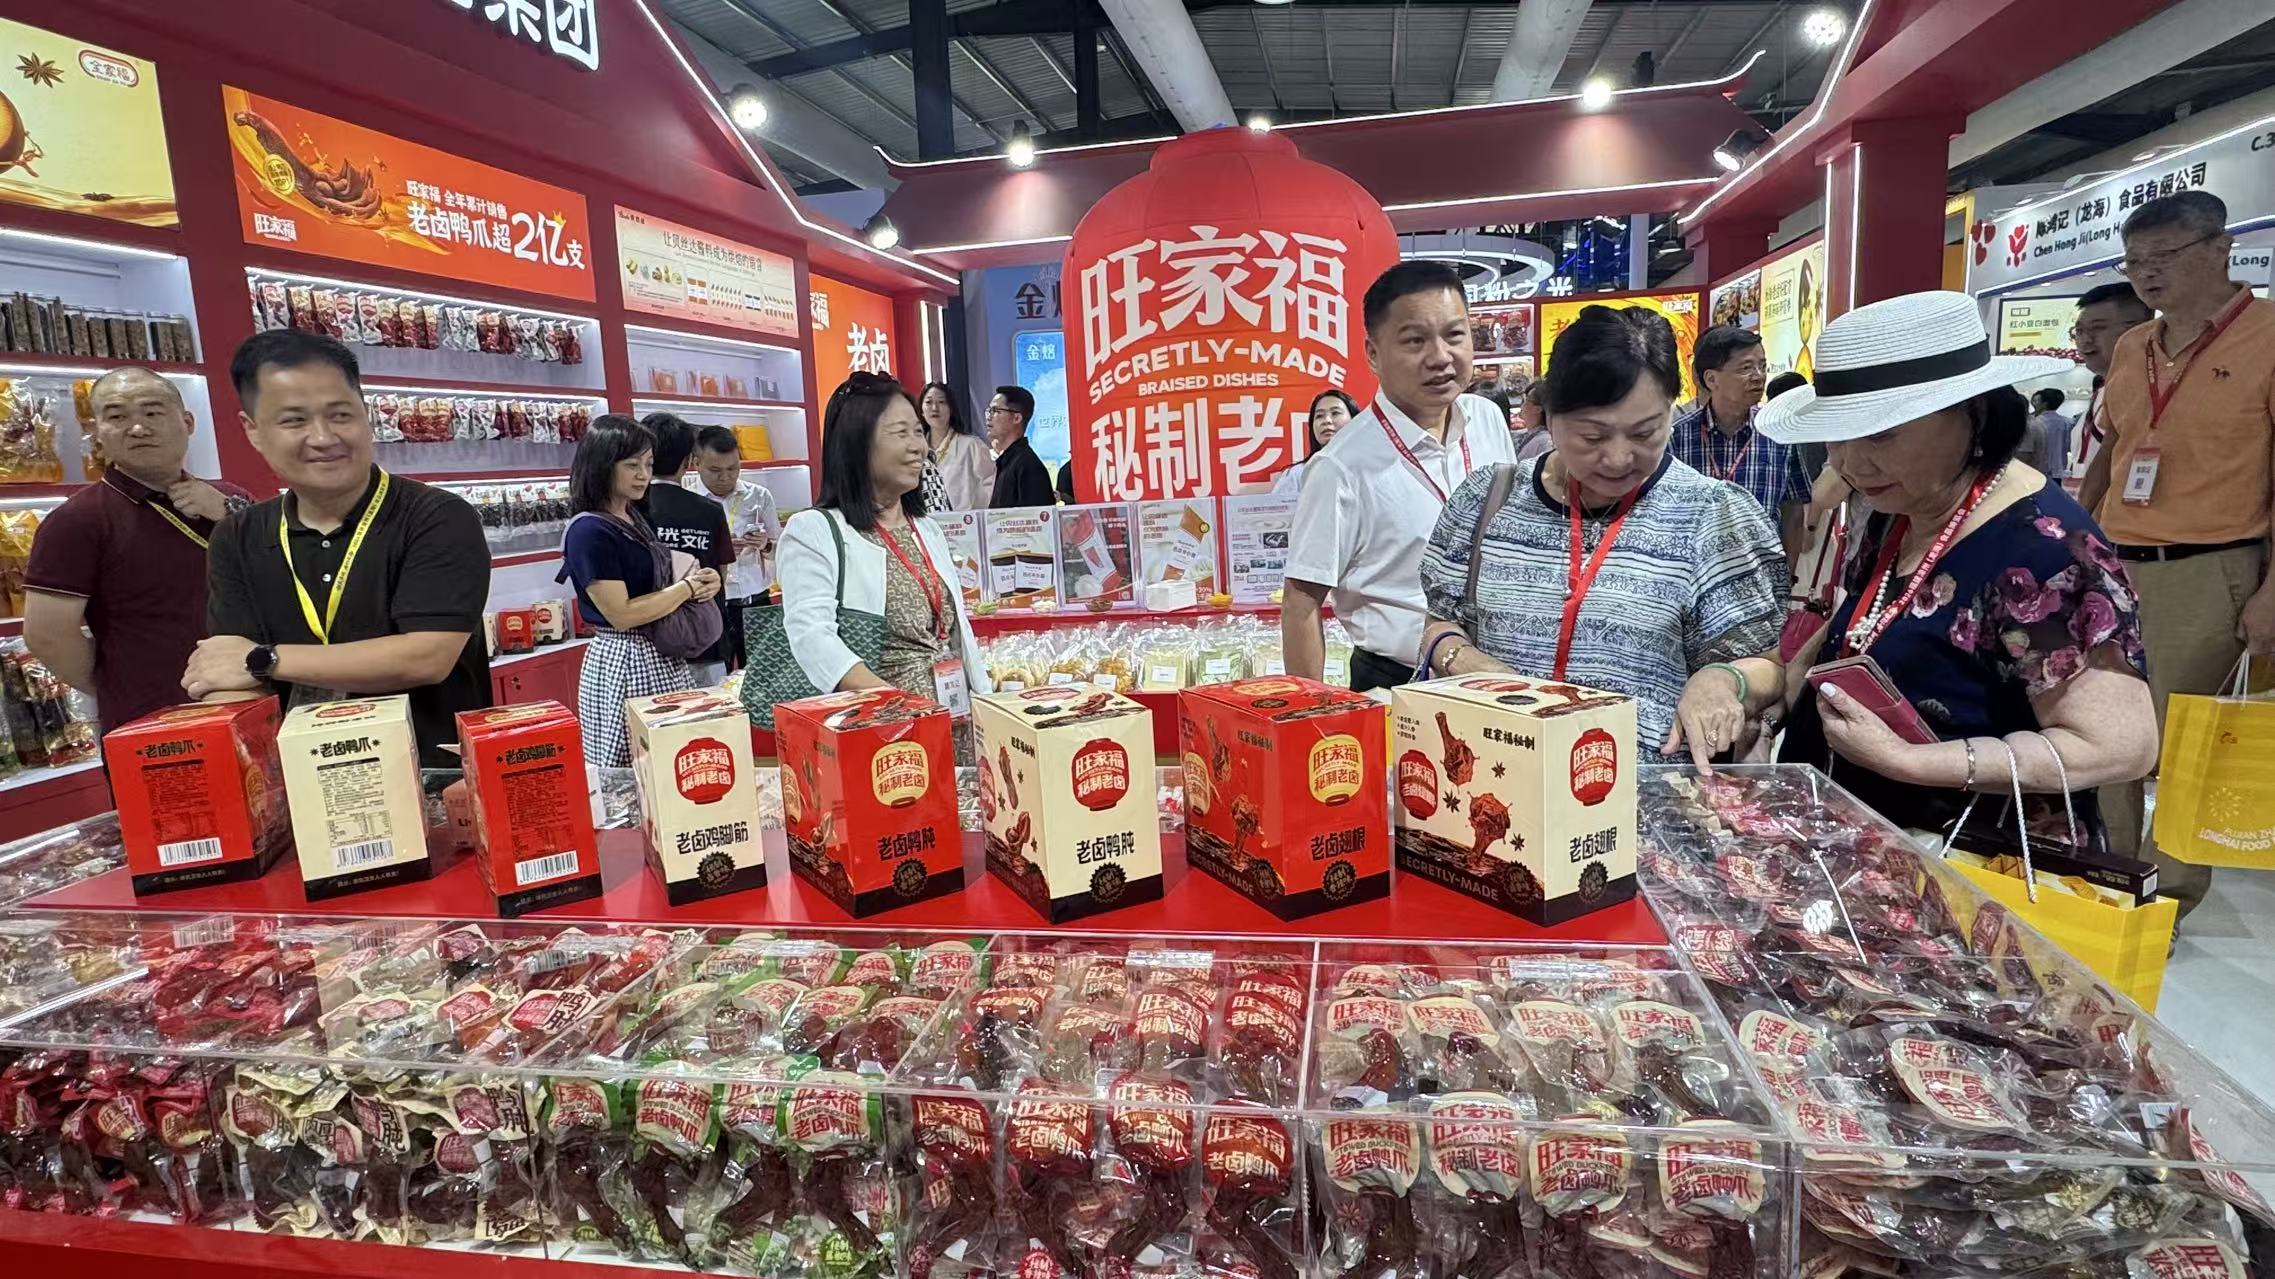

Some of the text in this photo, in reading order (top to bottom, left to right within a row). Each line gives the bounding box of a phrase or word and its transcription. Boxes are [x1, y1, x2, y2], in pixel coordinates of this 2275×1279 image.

[406, 180, 441, 205] 旺家福
[254, 212, 297, 240] 旺家福
[1081, 225, 1349, 381] 旺家福
[847, 321, 890, 375] 老卤
[1089, 338, 1347, 405] SECRETLY-MADE
[1138, 373, 1279, 397] BRAISED DISHES
[681, 535, 709, 550] 文化
[144, 739, 197, 758] 老卤鸭爪
[319, 737, 371, 759] 老卤鸭爪
[678, 748, 730, 776] 旺家福
[875, 749, 924, 776] 旺家福
[1075, 749, 1125, 776] 旺家福
[1313, 743, 1360, 772] 旺家福
[1573, 739, 1614, 769] 旺家福
[681, 770, 731, 793] 秘制老卤
[878, 773, 926, 796] 秘制老卤
[1077, 774, 1126, 798] 秘制老卤
[1314, 770, 1360, 793] 秘制老卤
[1574, 766, 1614, 792] 秘制老卤
[676, 821, 749, 855] 老卤鸡脚筋
[877, 826, 935, 861] 老卤鸭肫
[1076, 830, 1135, 864] 老卤鸭肫
[1311, 826, 1366, 861] 老卤翅根
[1570, 826, 1617, 863] 老卤翅根
[917, 1101, 983, 1132] 旺家福
[1015, 1102, 1089, 1136] 旺家福
[1206, 1115, 1286, 1160] 旺家福
[1330, 1119, 1411, 1151] 旺家福
[1207, 1151, 1280, 1182] 老卤鸭爪
[1332, 1149, 1414, 1177] 老卤鸭爪
[1439, 1148, 1521, 1178] 秘制老卤
[1537, 1137, 1622, 1175] 旺家福
